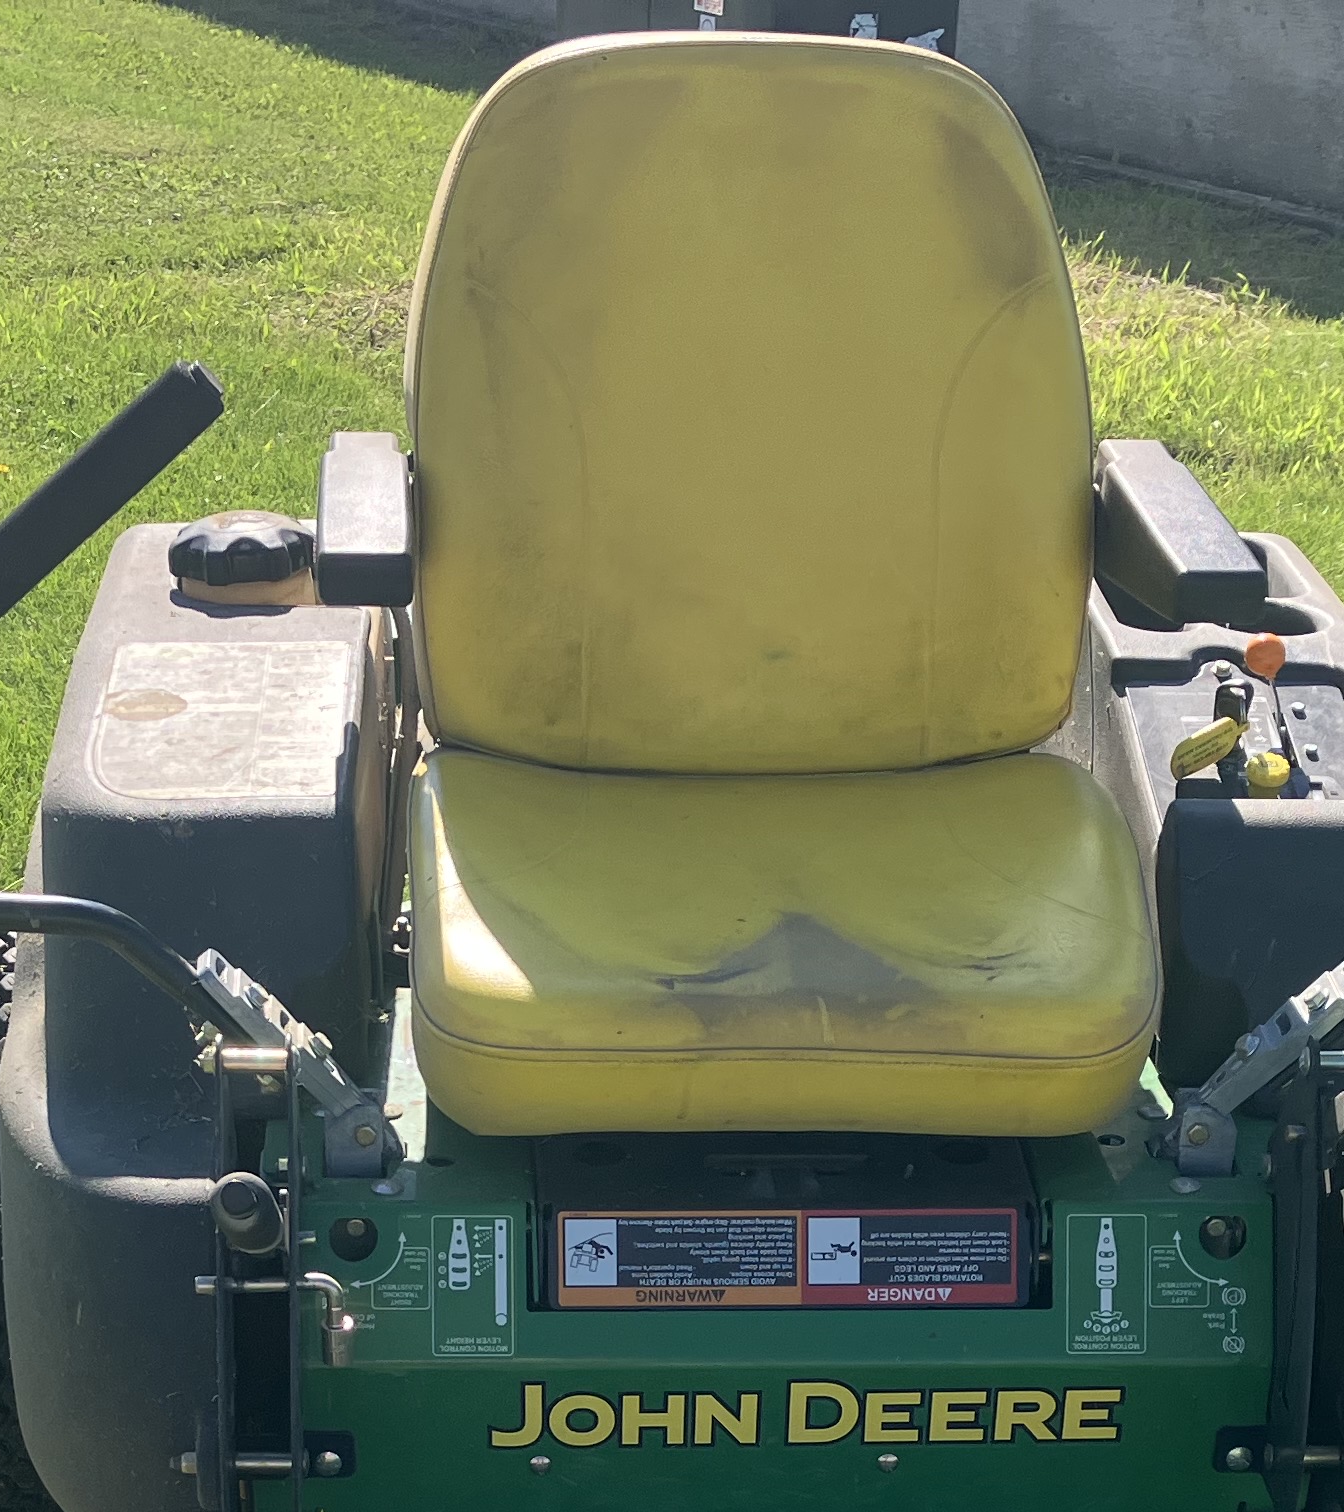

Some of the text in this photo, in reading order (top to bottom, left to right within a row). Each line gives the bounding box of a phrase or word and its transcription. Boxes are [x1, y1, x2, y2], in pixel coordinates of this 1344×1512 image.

[860, 1239, 886, 1247] backing
[894, 1265, 917, 1273] LEGS
[936, 1264, 961, 1272] ARMS
[962, 1264, 979, 1272] OFF
[639, 1278, 667, 1286] DEATH
[668, 1278, 681, 1286] OR
[682, 1278, 712, 1286] INJURY
[907, 1274, 941, 1282] BLADES
[941, 1274, 984, 1282] ROTATING
[635, 1289, 712, 1303] WARNING
[867, 1288, 936, 1300] DANGER
[1207, 1321, 1226, 1329] Park
[445, 1337, 502, 1345] LEVER HEIGHT
[1112, 1334, 1137, 1342] LEVER
[439, 1345, 477, 1353] CONTROL
[489, 1380, 1123, 1449] JOHN DEERE
